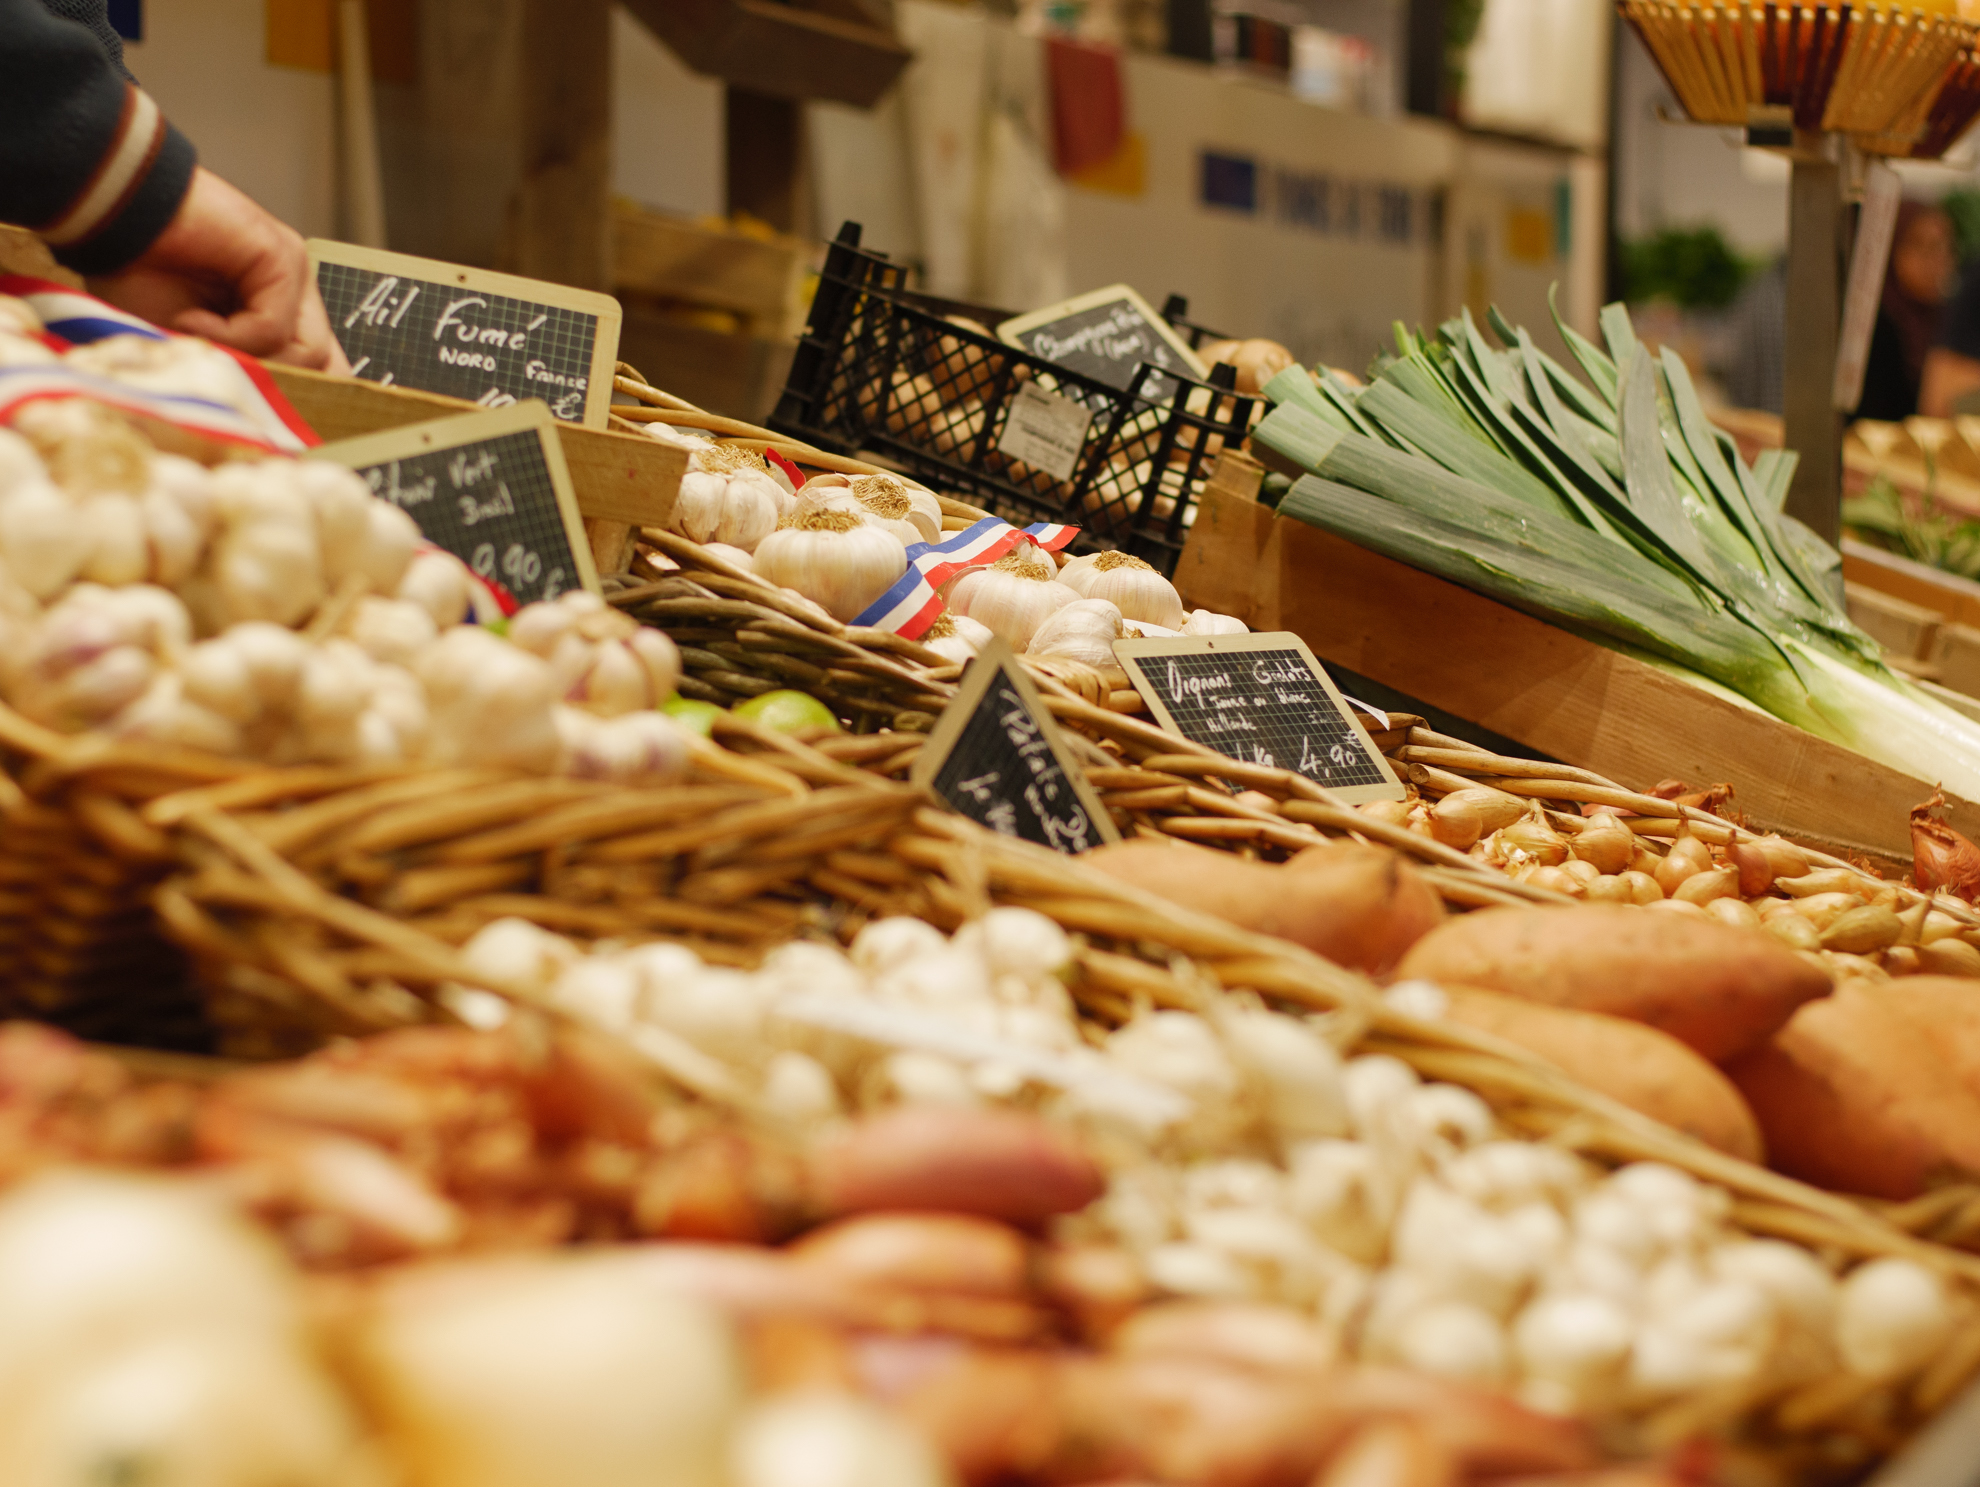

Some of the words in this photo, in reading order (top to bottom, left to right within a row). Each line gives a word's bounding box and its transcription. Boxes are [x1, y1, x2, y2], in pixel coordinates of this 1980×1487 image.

[344, 276, 420, 329] Ail
[438, 346, 497, 372] NORD
[525, 360, 588, 390] France
